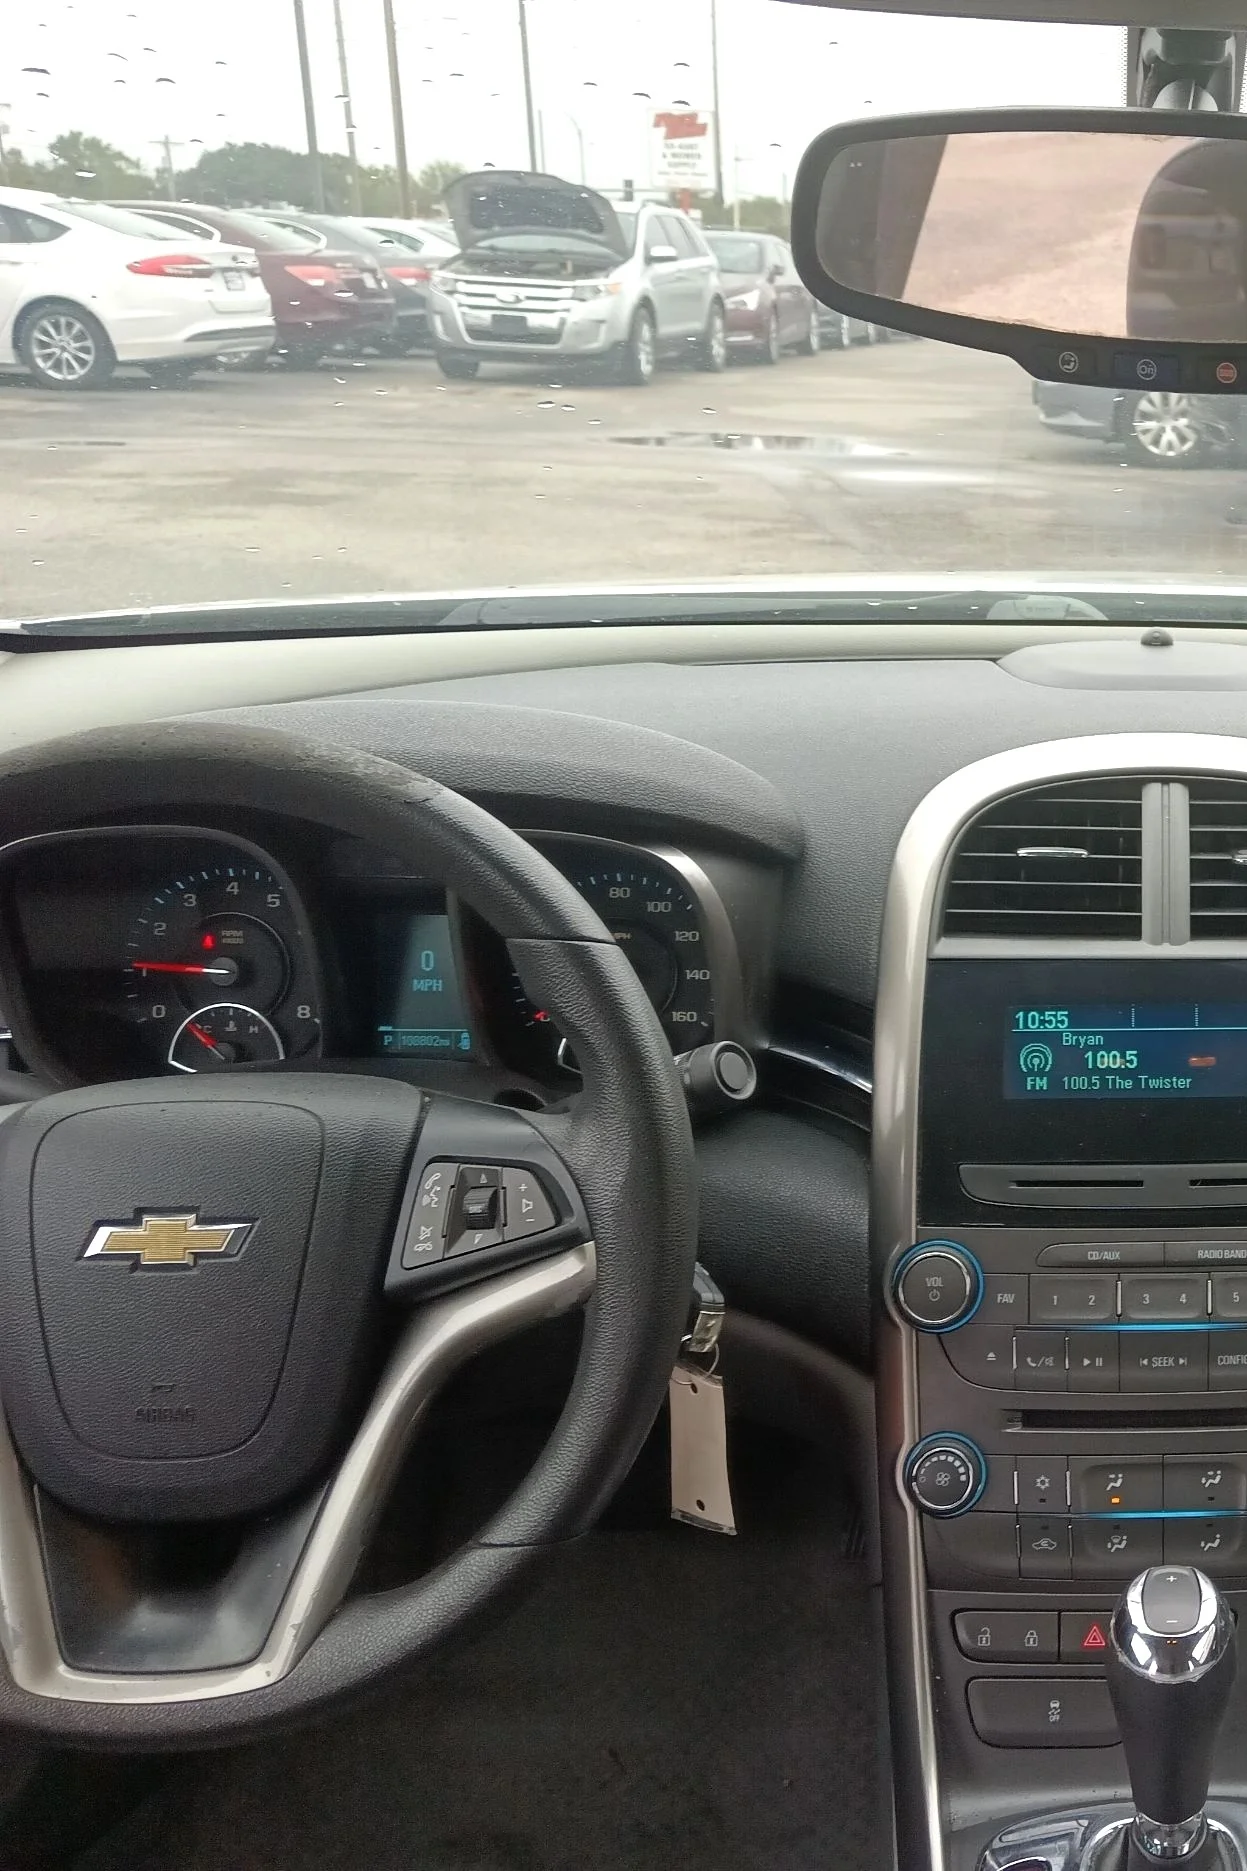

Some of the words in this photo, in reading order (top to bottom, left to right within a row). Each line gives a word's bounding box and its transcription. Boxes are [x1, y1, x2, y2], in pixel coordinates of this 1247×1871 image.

[226, 881, 239, 895] 4
[609, 887, 630, 898] 80
[183, 894, 197, 907] 3
[267, 894, 280, 907] 5
[648, 901, 671, 913] 100
[154, 922, 167, 935] 2
[675, 930, 699, 942] 120
[421, 950, 434, 971] 0
[685, 969, 710, 980] 140
[412, 979, 442, 992] MPH
[152, 1005, 166, 1018] 0
[297, 1005, 310, 1018] 8
[672, 1011, 697, 1022] 160
[1015, 1011, 1069, 1029] 10:55
[383, 1035, 392, 1045] P
[1062, 1033, 1104, 1048] Bryan
[1084, 1050, 1138, 1069] 100.5
[1026, 1077, 1048, 1090] FM
[1062, 1076, 1100, 1090] 100.5
[1105, 1075, 1133, 1089] The
[1138, 1075, 1192, 1089] Twister
[1087, 1251, 1121, 1260] CD/AUX
[1197, 1250, 1223, 1259] RADIO
[1224, 1250, 1247, 1259] BAND
[925, 1277, 944, 1287] VOL
[997, 1293, 1015, 1303] FAV
[1052, 1295, 1058, 1305] 1
[1088, 1295, 1096, 1306] 2
[1142, 1294, 1150, 1305] 3
[1179, 1293, 1187, 1304] 4
[1232, 1291, 1240, 1303] 5
[1151, 1355, 1175, 1367] SEEK
